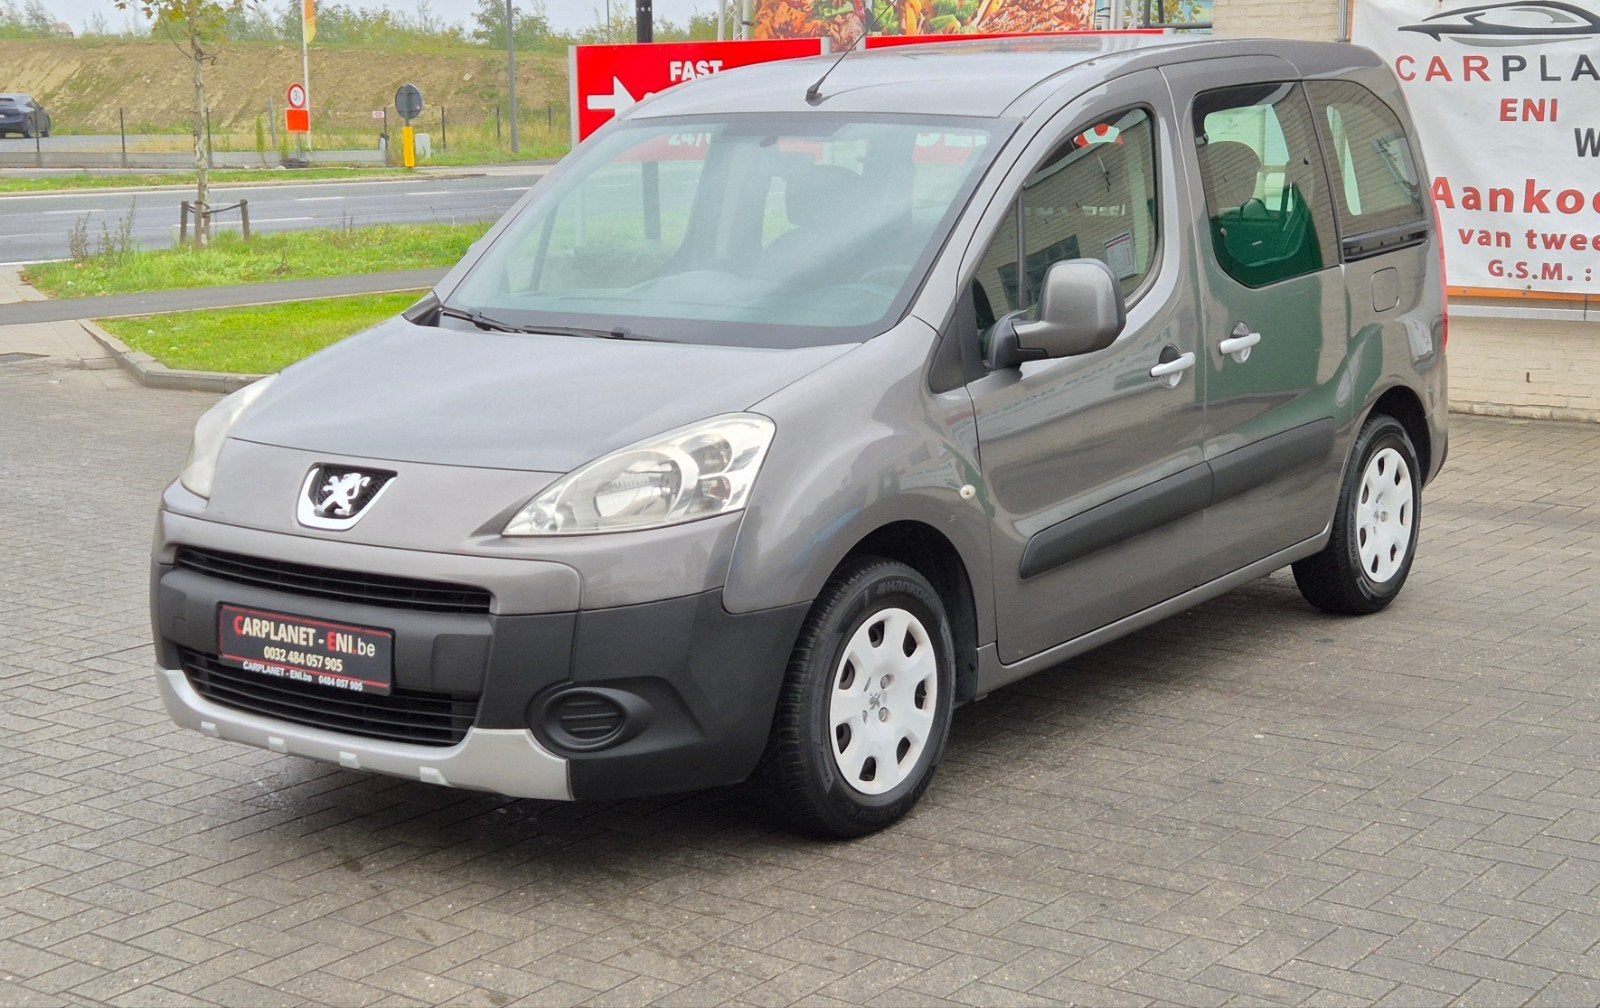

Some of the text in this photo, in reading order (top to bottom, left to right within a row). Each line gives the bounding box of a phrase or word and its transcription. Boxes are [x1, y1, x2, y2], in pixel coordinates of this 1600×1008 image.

[669, 60, 723, 81] FAST
[1395, 54, 1600, 82] CARPLA
[1500, 98, 1558, 122] ENI
[1432, 176, 1600, 214] Aanko
[1458, 228, 1512, 248] van
[1488, 259, 1573, 281] G.S.M.
[233, 615, 316, 647] CARPLANET
[327, 631, 376, 657] ENI.be
[242, 661, 286, 677] CARPLANET
[263, 646, 343, 672] 0032 484 057 905
